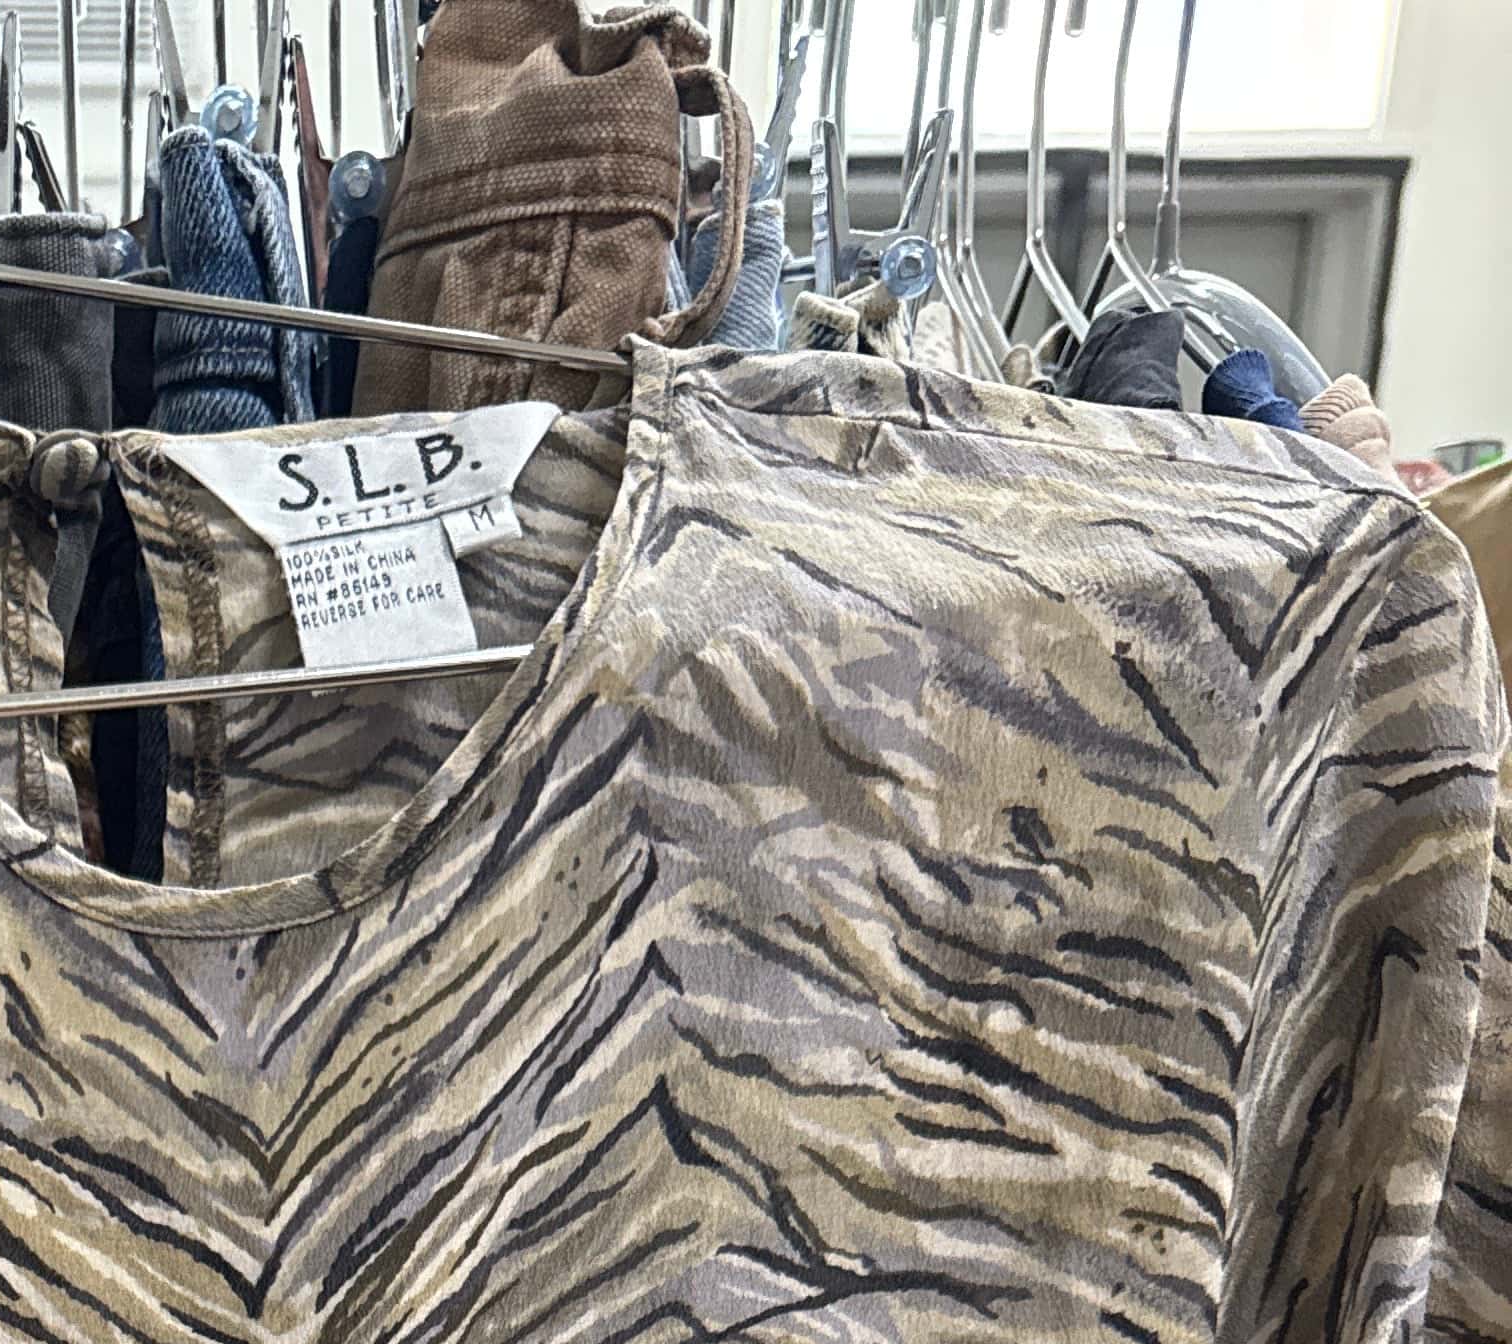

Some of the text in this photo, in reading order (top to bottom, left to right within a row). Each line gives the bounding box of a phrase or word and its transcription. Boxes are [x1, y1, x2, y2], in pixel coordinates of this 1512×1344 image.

[278, 433, 482, 511] S.L.B.
[316, 492, 438, 530] PETITE
[468, 504, 495, 531] M
[291, 546, 416, 589] MADE IN CHINA
[295, 591, 318, 609] RN
[301, 583, 445, 631] REVERSE FOR CARE
